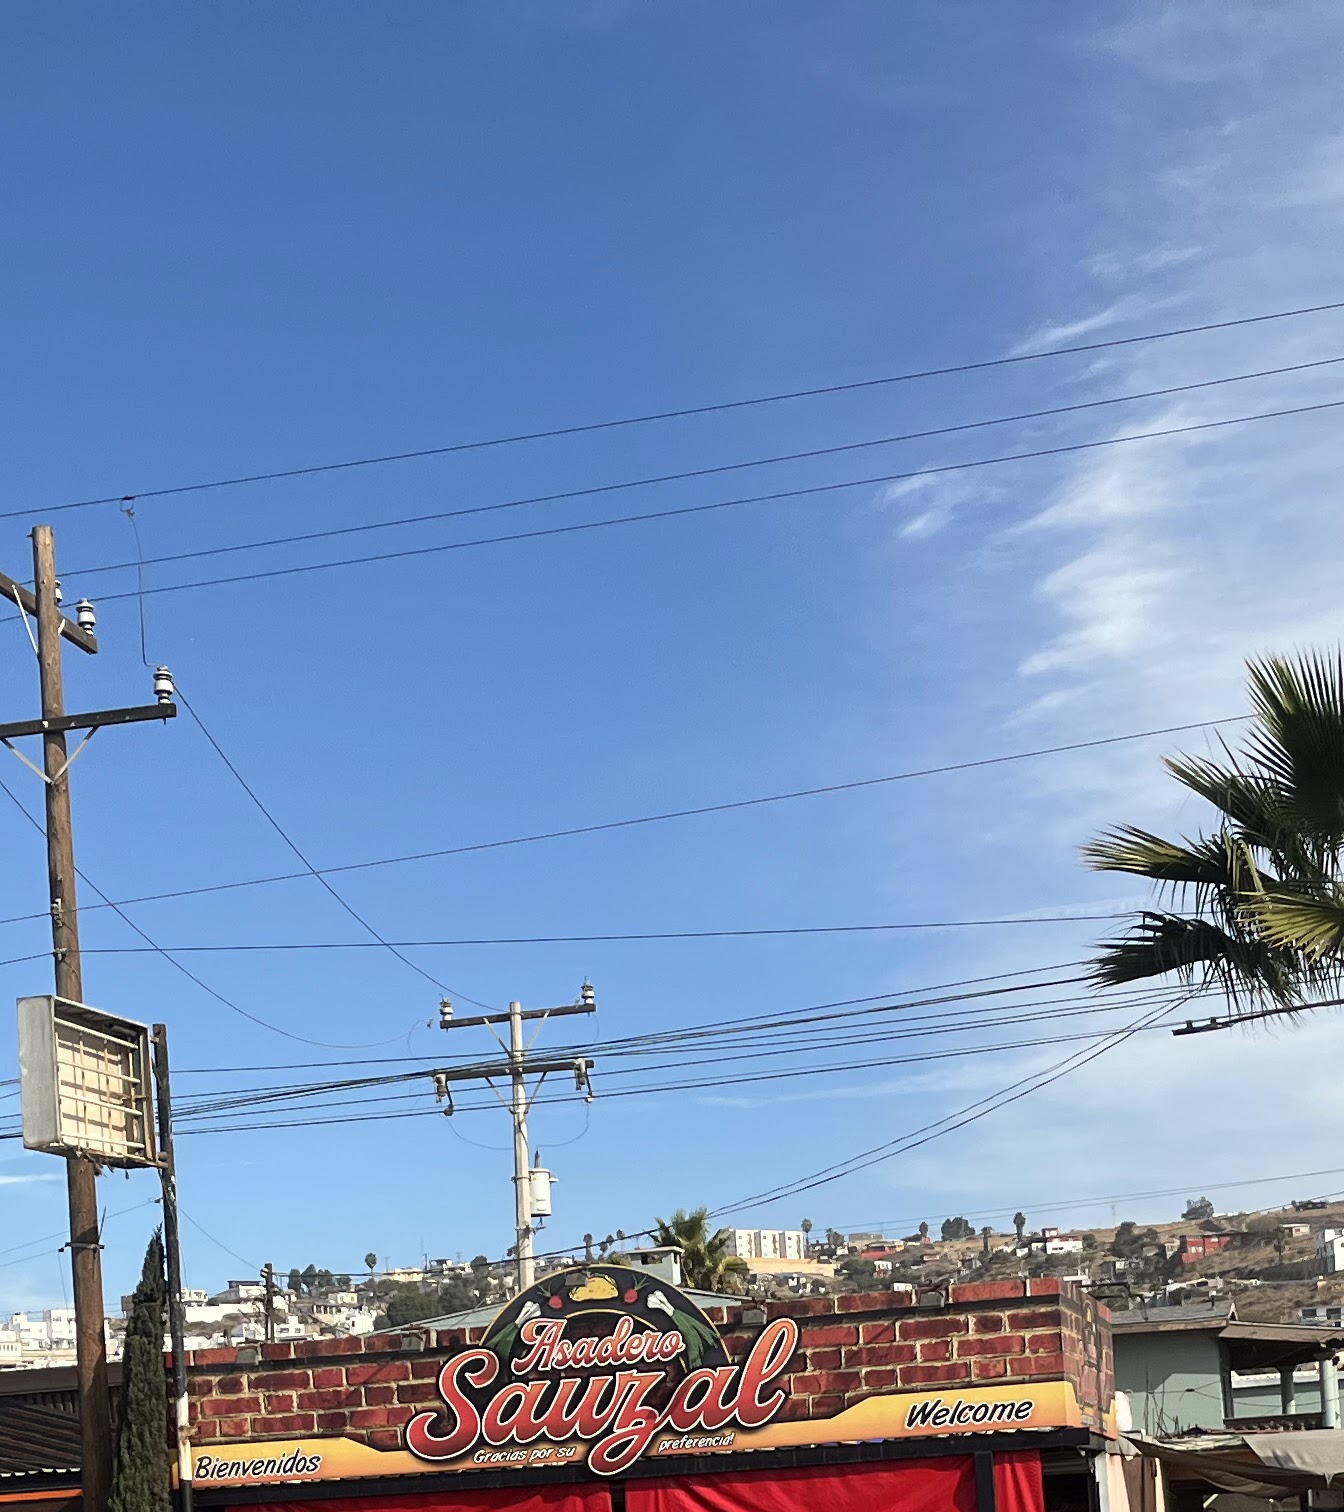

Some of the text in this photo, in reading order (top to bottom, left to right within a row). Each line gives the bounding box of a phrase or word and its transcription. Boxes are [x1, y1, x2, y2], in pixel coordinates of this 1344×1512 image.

[511, 1315, 685, 1376] Asadero
[406, 1317, 798, 1476] Sauzal
[906, 1398, 1034, 1429] Welcome
[195, 1448, 322, 1480] Bienvenidos
[473, 1432, 735, 1464] Gracias por su preferencia!
